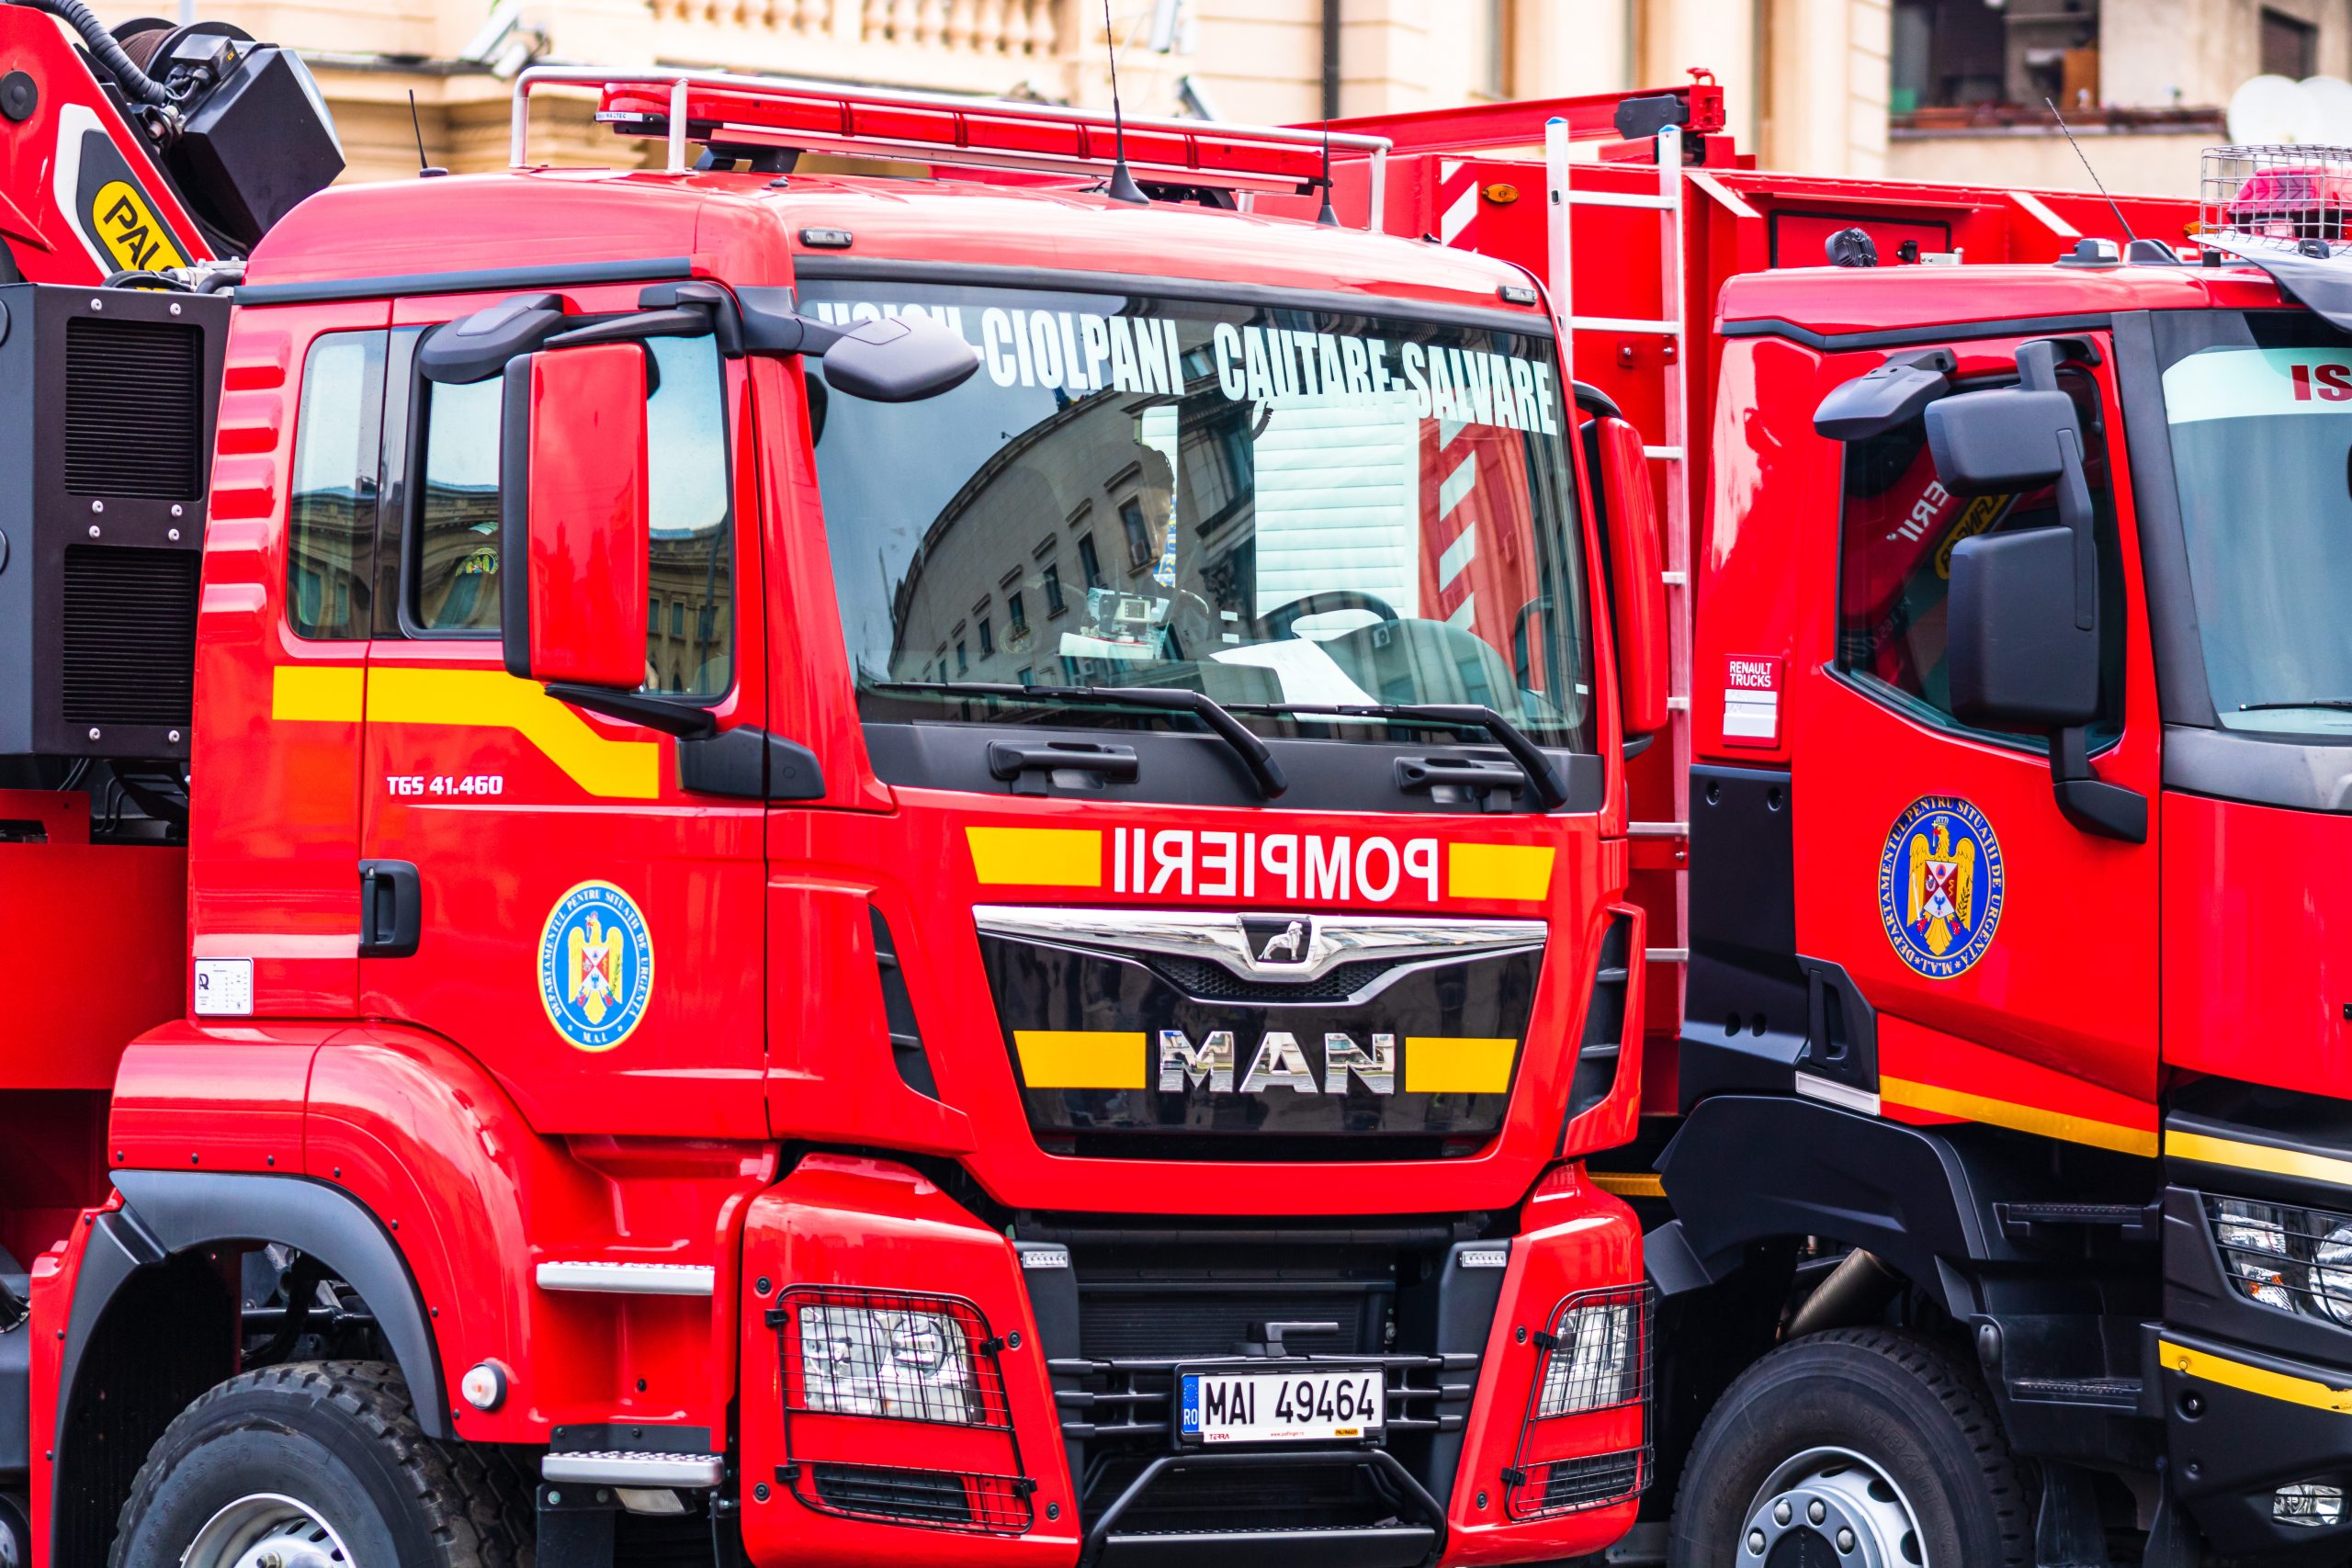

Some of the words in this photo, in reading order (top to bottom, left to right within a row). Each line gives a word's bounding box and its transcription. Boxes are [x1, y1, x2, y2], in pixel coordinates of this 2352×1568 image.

[103, 195, 173, 272] PAL
[818, 302, 1185, 395] -CIOLPANI
[1729, 661, 1771, 675] RENAULT
[1729, 673, 1771, 687] TRUCKS
[387, 776, 424, 795] TGS
[429, 776, 503, 795] 41.460
[1882, 821, 1915, 963] DEPARTAMENTUL
[1905, 796, 1954, 820] PENTRU
[1991, 863, 2002, 888] DE
[543, 910, 567, 1017] DEPARTAMENTUL
[566, 889, 601, 910] PENTRU
[637, 932, 648, 951] DE
[1159, 1030, 1396, 1095] MAN
[1183, 1409, 1198, 1426] RO
[1205, 1382, 1255, 1425] MAI
[1275, 1378, 1374, 1423] 49464
